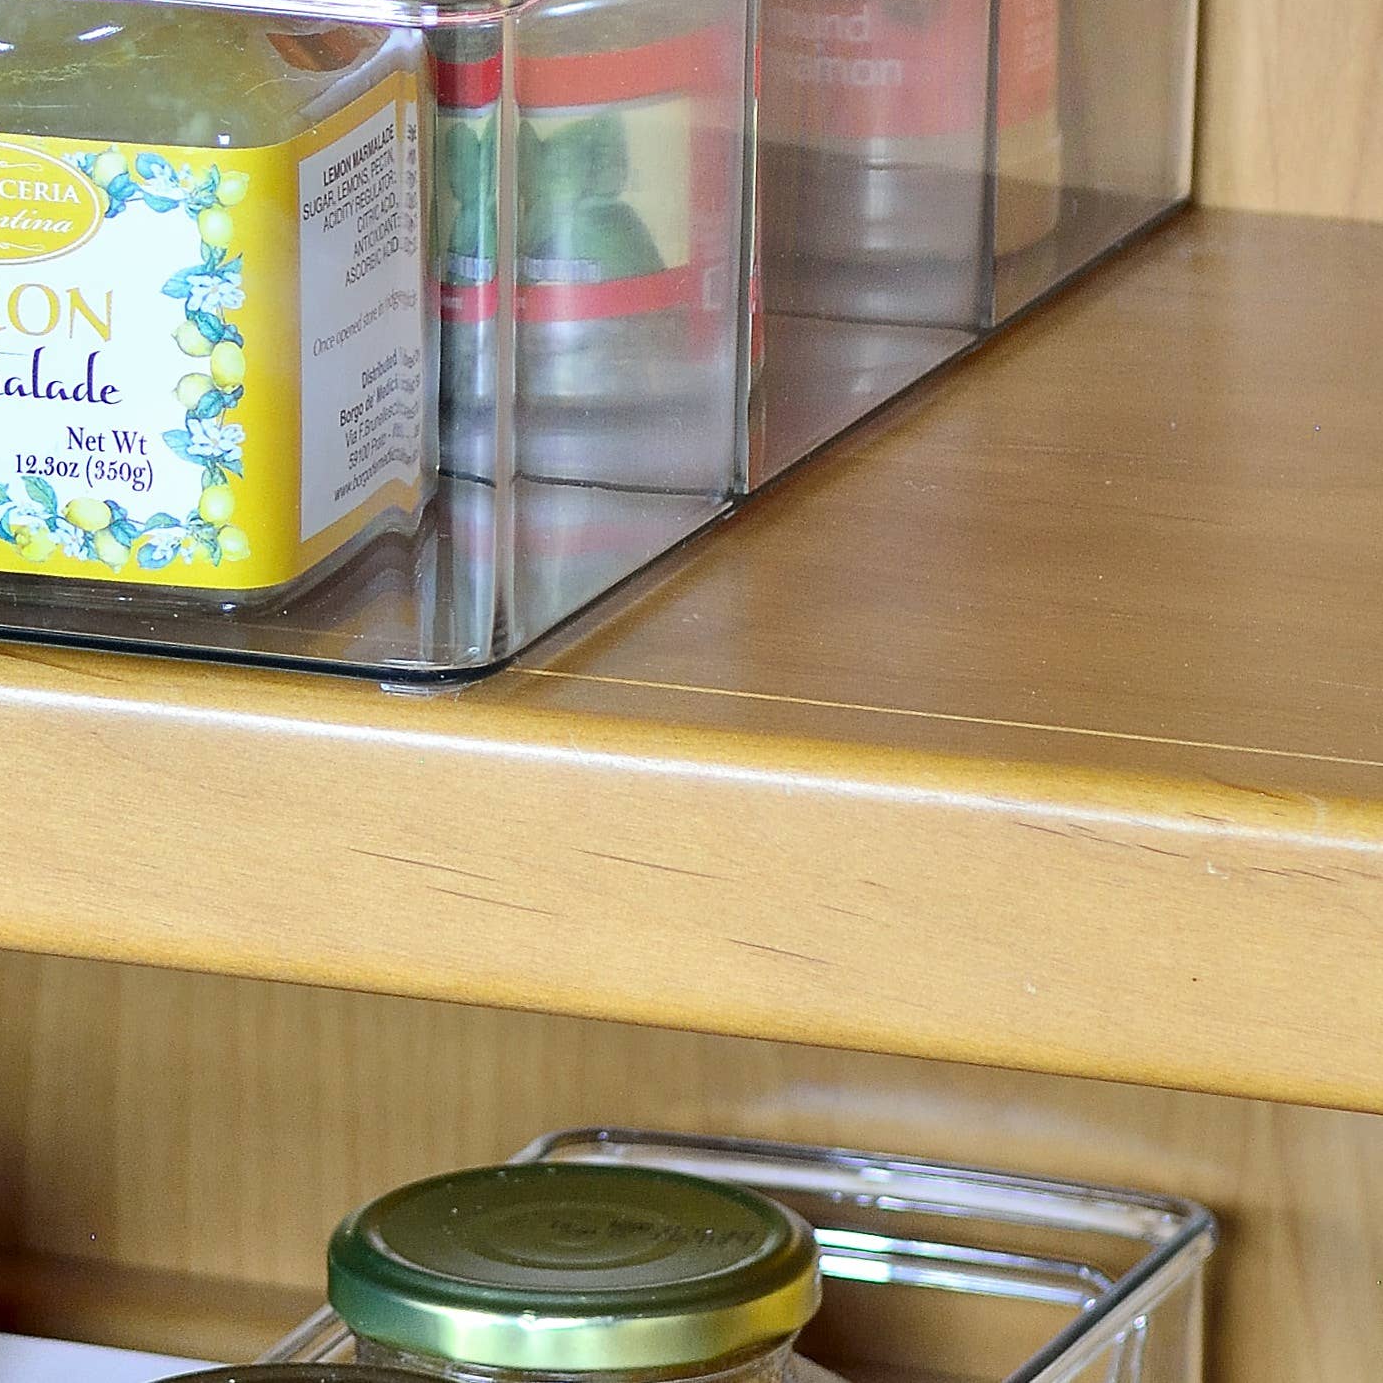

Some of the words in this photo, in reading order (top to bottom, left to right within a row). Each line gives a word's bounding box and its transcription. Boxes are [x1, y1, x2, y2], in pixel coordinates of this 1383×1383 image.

[323, 155, 352, 187] LEMON
[339, 400, 365, 428] Borgo
[66, 425, 105, 453] Net
[111, 430, 148, 456] Wt
[15, 453, 81, 478] 12.3oz
[85, 455, 154, 492] (350g)
